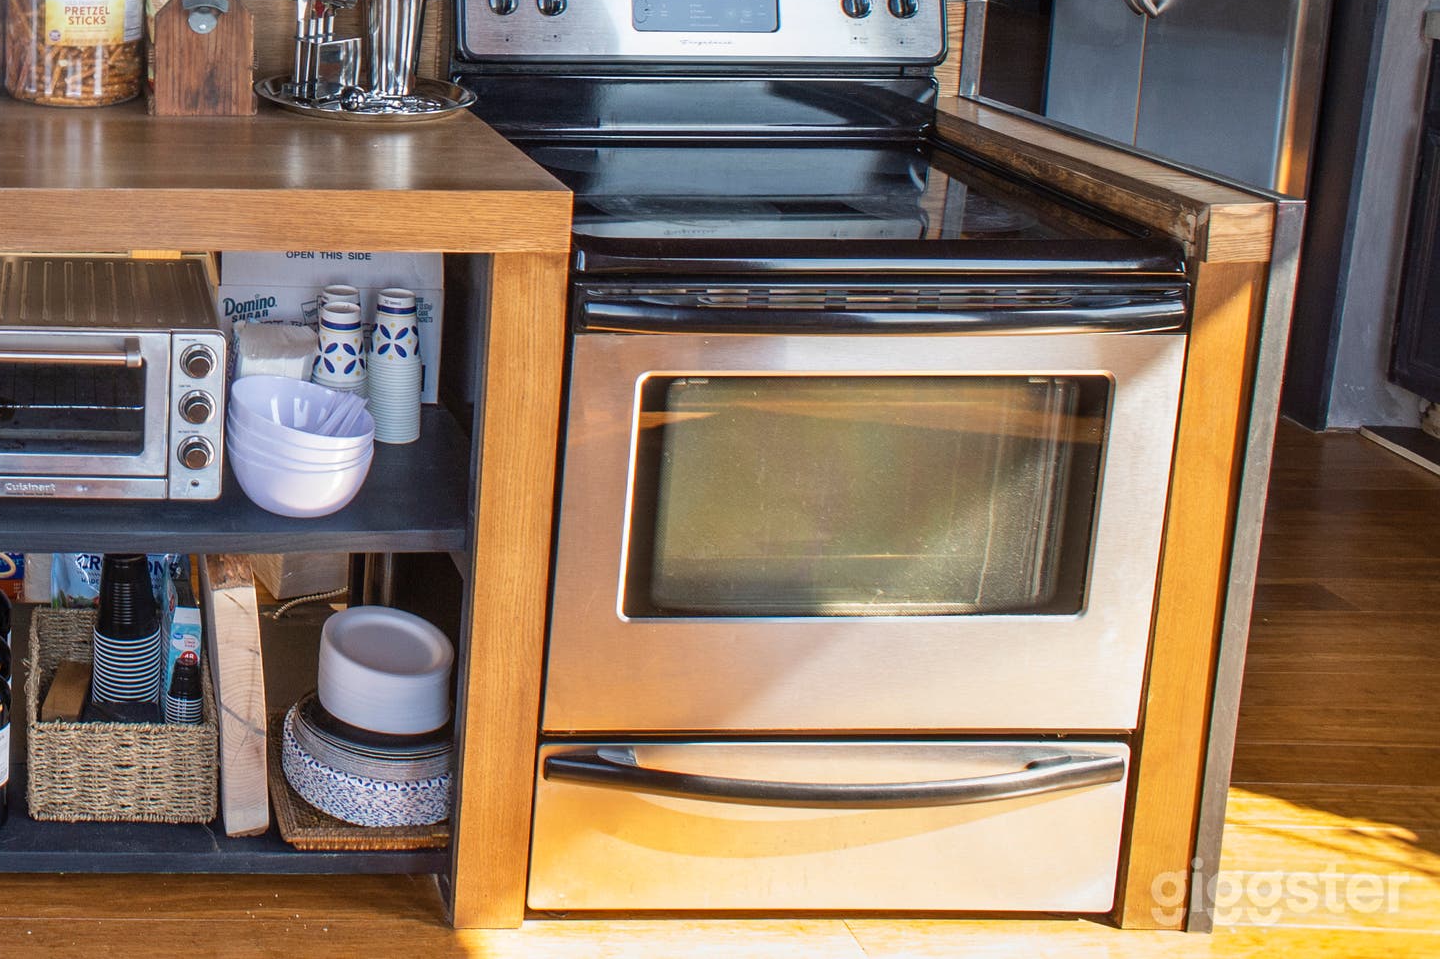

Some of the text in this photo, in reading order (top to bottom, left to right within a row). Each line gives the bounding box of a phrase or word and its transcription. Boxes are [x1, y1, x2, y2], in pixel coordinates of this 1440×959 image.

[64, 6, 111, 15] PRETZEL
[68, 16, 107, 25] STICKS
[285, 251, 372, 261] OPEN THIS SIDE
[223, 294, 277, 318] Domino
[4, 482, 56, 492] Cuisinart
